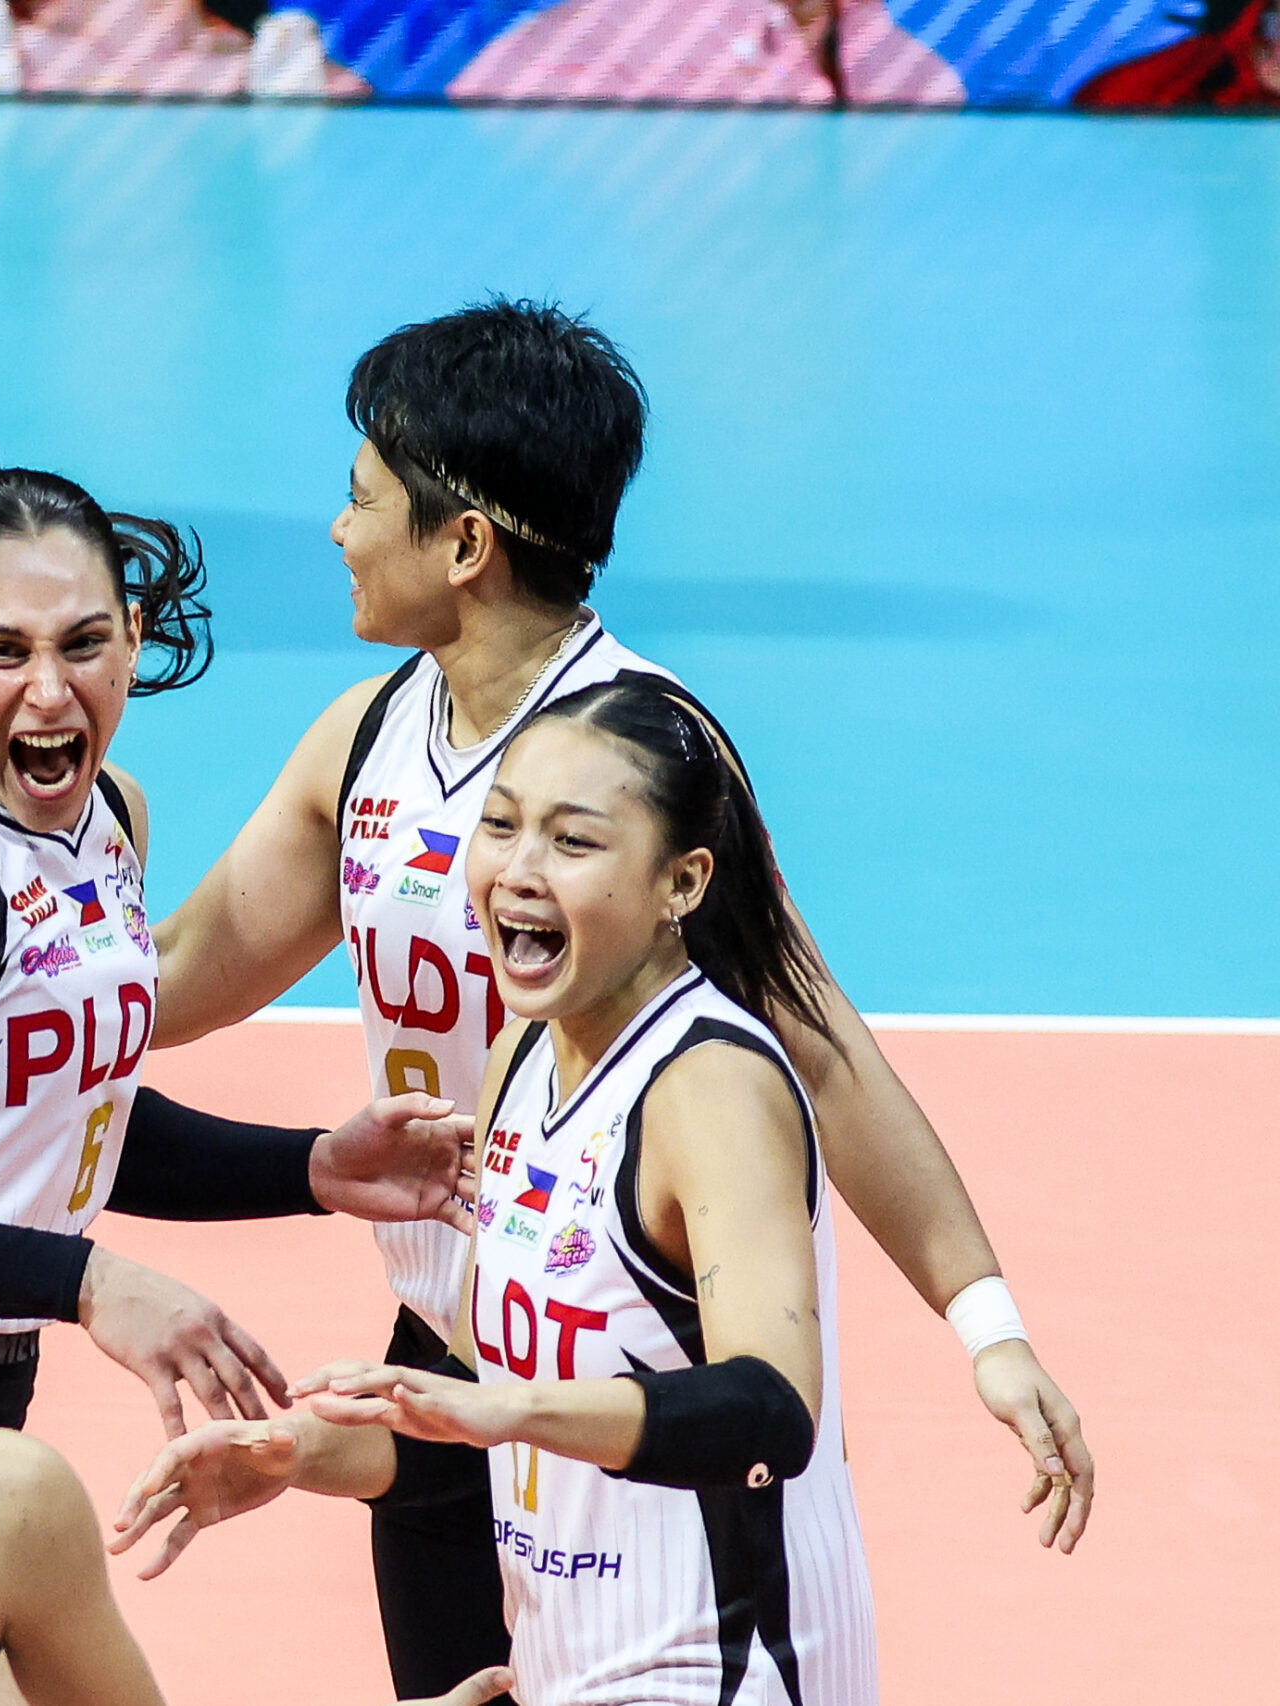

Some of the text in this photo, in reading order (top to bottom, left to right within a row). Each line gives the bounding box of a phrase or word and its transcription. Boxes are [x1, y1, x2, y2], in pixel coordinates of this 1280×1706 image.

[411, 879, 441, 901] Smart
[6, 976, 159, 1108] PLD
[67, 1101, 114, 1216] 6
